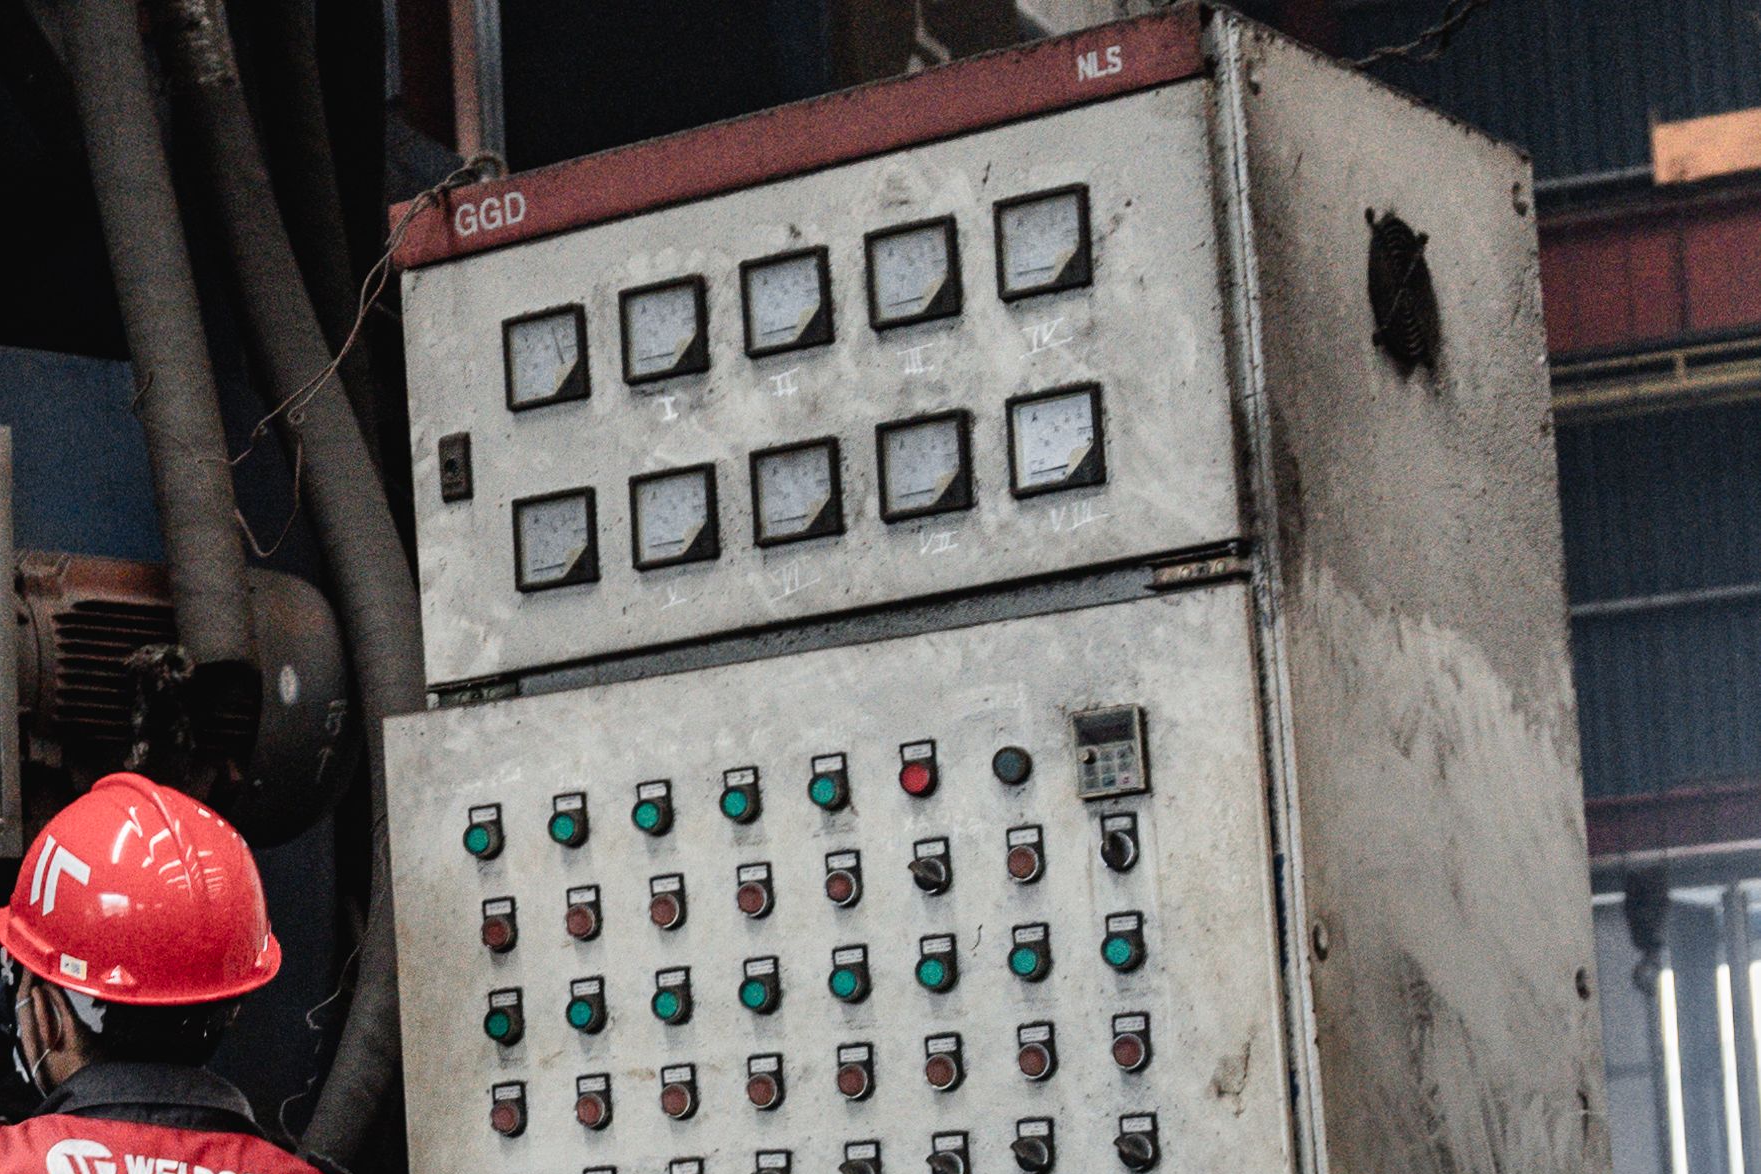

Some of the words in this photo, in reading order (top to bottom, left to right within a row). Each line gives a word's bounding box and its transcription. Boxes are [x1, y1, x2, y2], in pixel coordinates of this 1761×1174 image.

[1076, 45, 1123, 82] NLS
[454, 191, 526, 237] GGD
[769, 366, 801, 397] II
